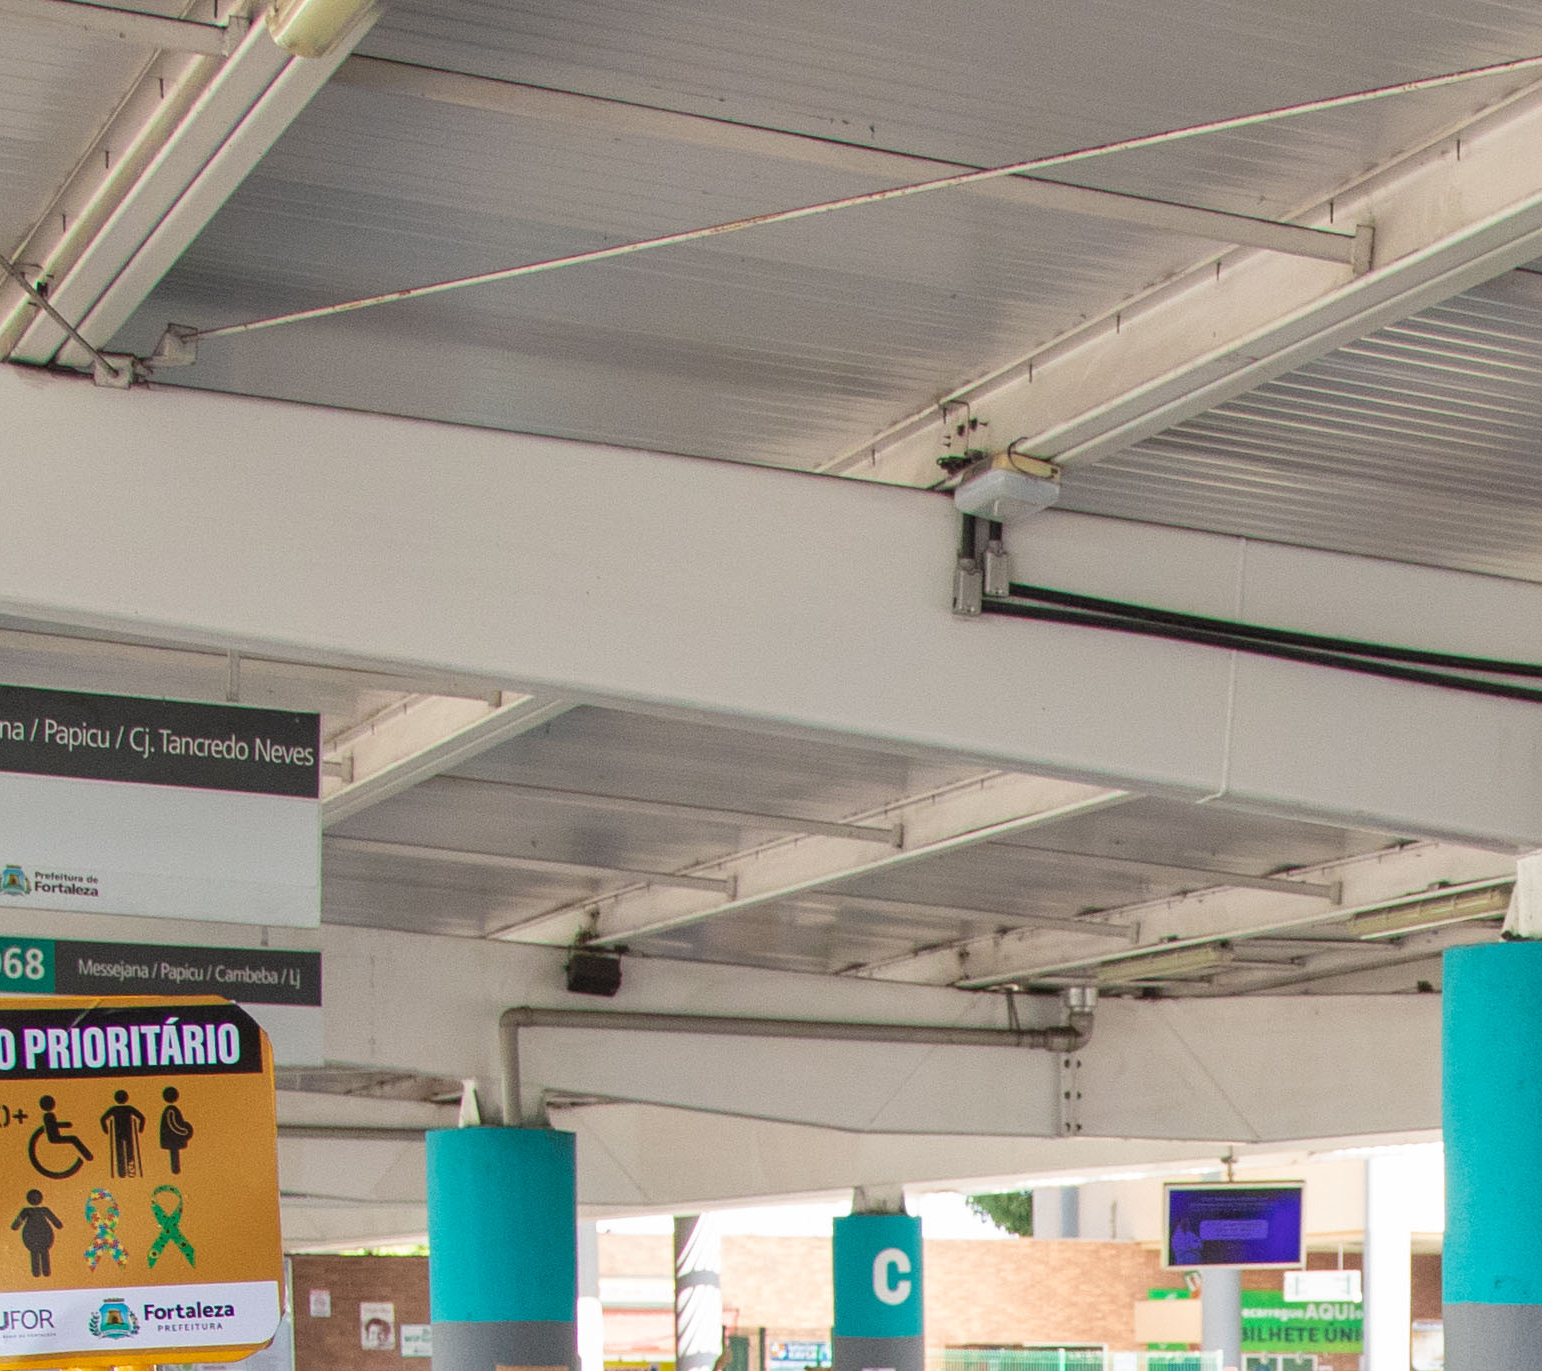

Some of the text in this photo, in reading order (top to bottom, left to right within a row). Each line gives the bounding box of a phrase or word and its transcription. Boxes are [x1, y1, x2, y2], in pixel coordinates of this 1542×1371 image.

[45, 723, 110, 753] Papicu
[129, 728, 155, 759] Cj.
[159, 730, 248, 761] Tancredo
[255, 738, 314, 766] Neves
[34, 870, 99, 884] Prefeitura de
[34, 881, 99, 897] Fortaleza
[78, 958, 148, 981] Messejana
[161, 964, 204, 983] Papicu
[215, 966, 278, 985] Cambeba
[289, 969, 301, 989] Lj
[24, 1016, 241, 1070] PRIORITÁRIO
[872, 1247, 912, 1306] C
[143, 1301, 235, 1322] Fortaleza
[1305, 1303, 1355, 1321] AQUI
[157, 1322, 224, 1333] PREFEITURA
